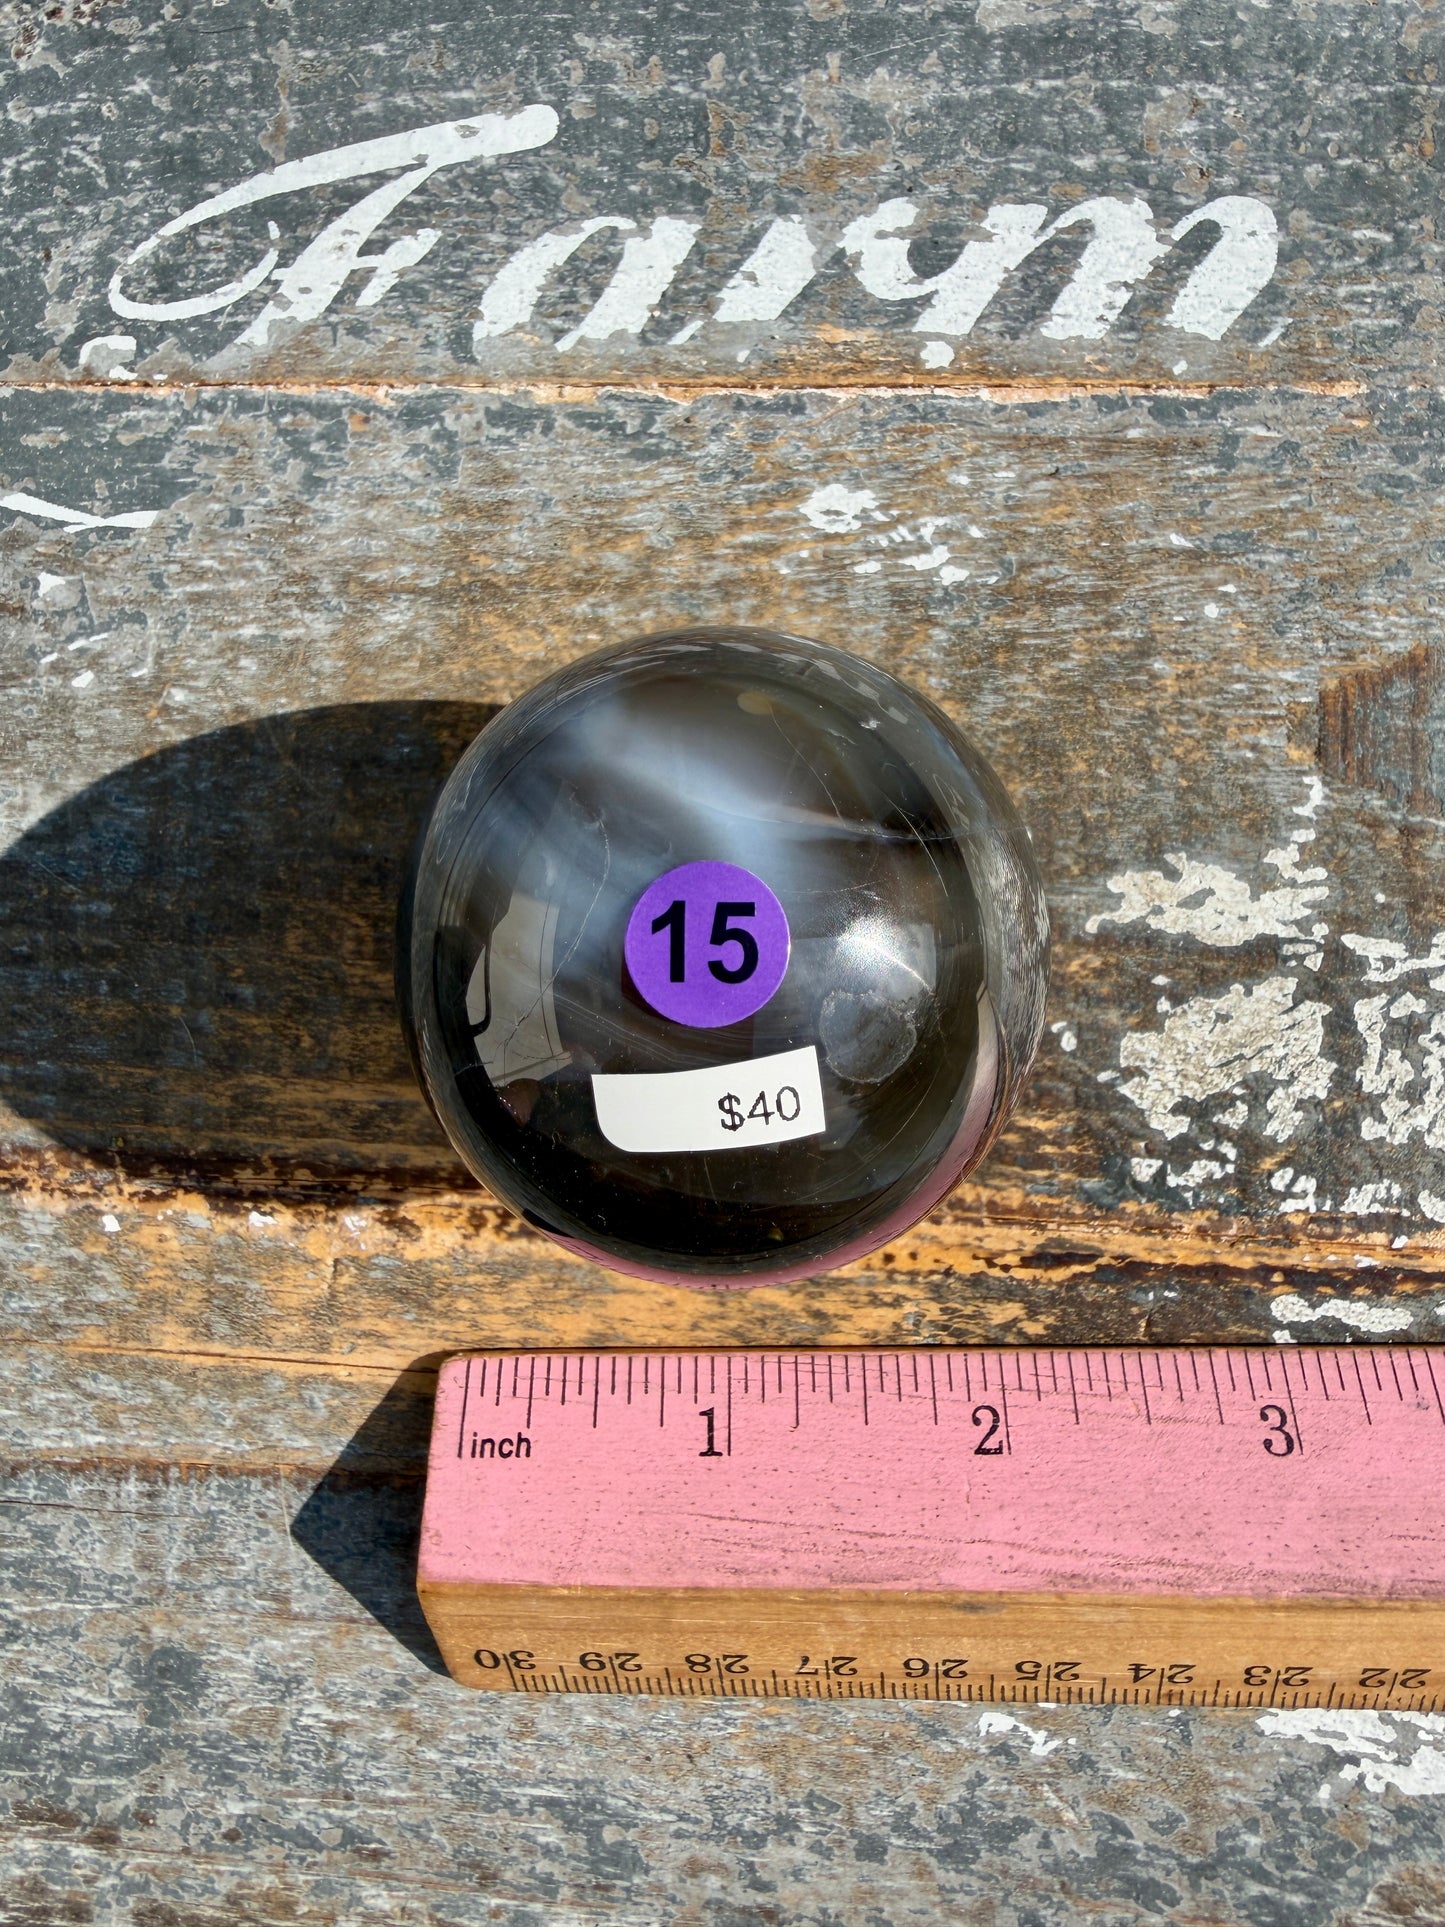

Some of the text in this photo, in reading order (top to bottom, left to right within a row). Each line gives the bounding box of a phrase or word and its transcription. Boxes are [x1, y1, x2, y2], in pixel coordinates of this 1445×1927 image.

[78, 102, 1290, 378] Farm
[651, 899, 759, 984] 15
[717, 1085, 801, 1132] $40
[470, 1404, 1295, 1459] inch 1 2 3
[474, 1648, 1432, 1690] 30 29 28 27 26 25 24 23 22
